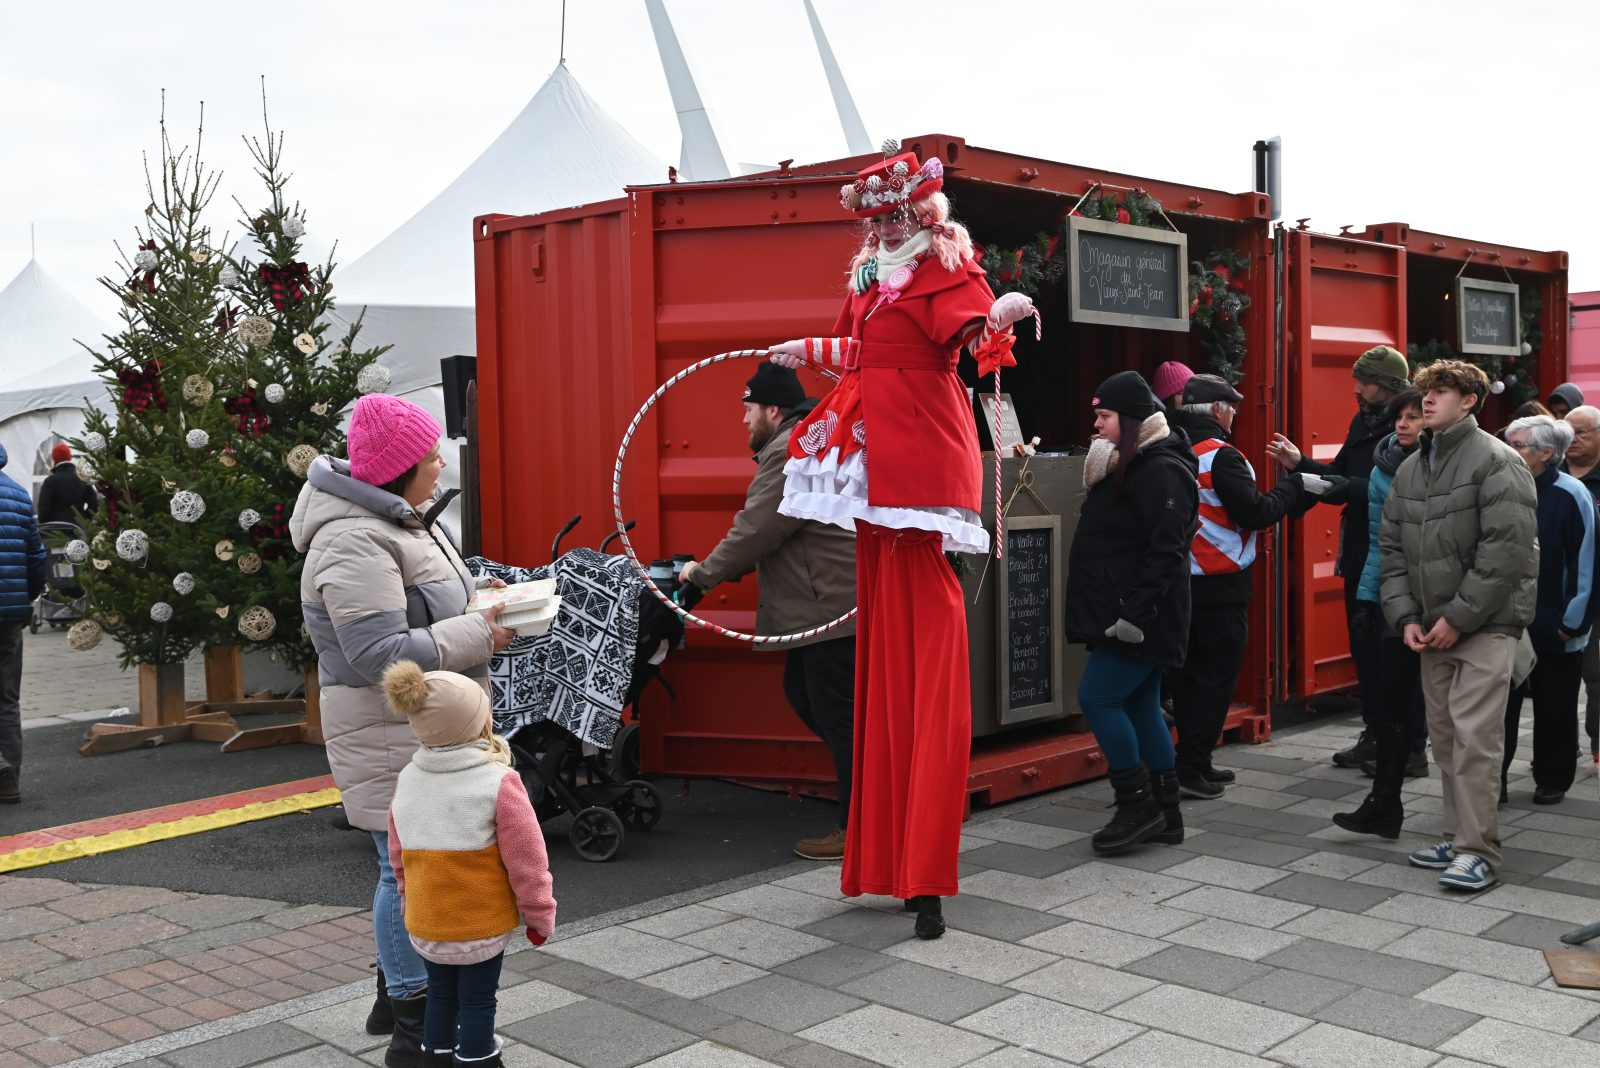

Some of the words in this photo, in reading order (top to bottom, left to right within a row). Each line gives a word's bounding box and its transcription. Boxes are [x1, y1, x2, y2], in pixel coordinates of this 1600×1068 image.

[1080, 238, 1131, 281] Magasin
[1136, 251, 1167, 280] général
[1121, 271, 1132, 284] du
[1089, 270, 1164, 309] Vieux-Saint-Jean
[1017, 532, 1033, 548] Vente
[1036, 535, 1045, 547] ici
[1009, 554, 1034, 571] Biscuits
[1017, 607, 1040, 618] bonbons
[1024, 633, 1032, 644] de
[1014, 647, 1039, 659] Bonbons
